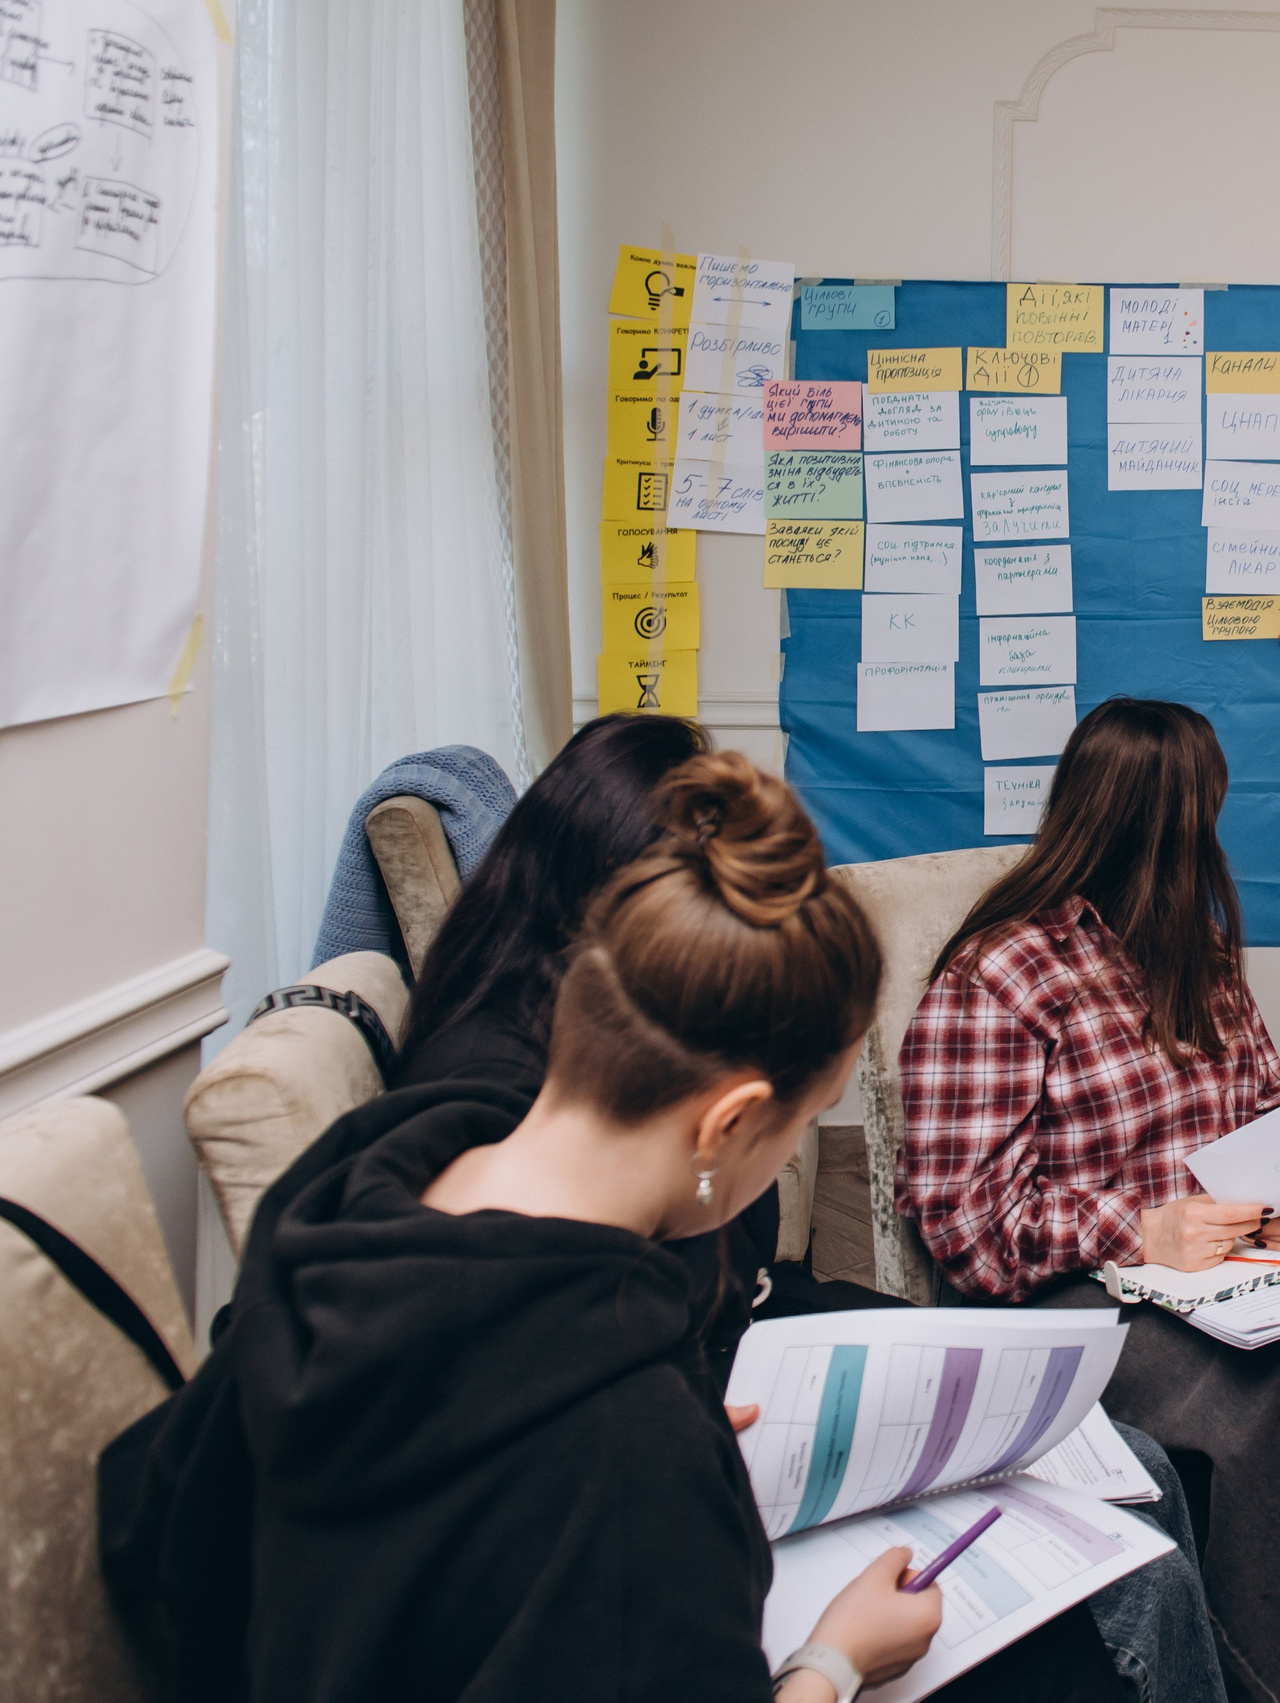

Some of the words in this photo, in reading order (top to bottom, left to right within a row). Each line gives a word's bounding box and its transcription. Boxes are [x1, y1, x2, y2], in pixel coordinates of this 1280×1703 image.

[630, 254, 651, 264] Кожна
[1120, 298, 1179, 316] МОЛОДІ
[616, 327, 651, 336] Говоримо
[1122, 319, 1174, 334] МАТЕРІ
[1111, 366, 1183, 384] ДИТЯЧА
[616, 395, 653, 403] Говоримо
[1118, 388, 1189, 402] ЛІКАРНЯ
[1221, 410, 1279, 434] ЦНАП
[1112, 436, 1195, 455] ДИТЯЧИЙ
[1118, 457, 1201, 474] МАЙДАНЧИК
[1211, 479, 1241, 499] СОЦ
[617, 527, 678, 537] ГОЛОСУВАННЯ
[1228, 559, 1277, 576] ЛІКАР
[612, 592, 642, 602] Процес
[628, 659, 668, 669] ТАЙМІНГ
